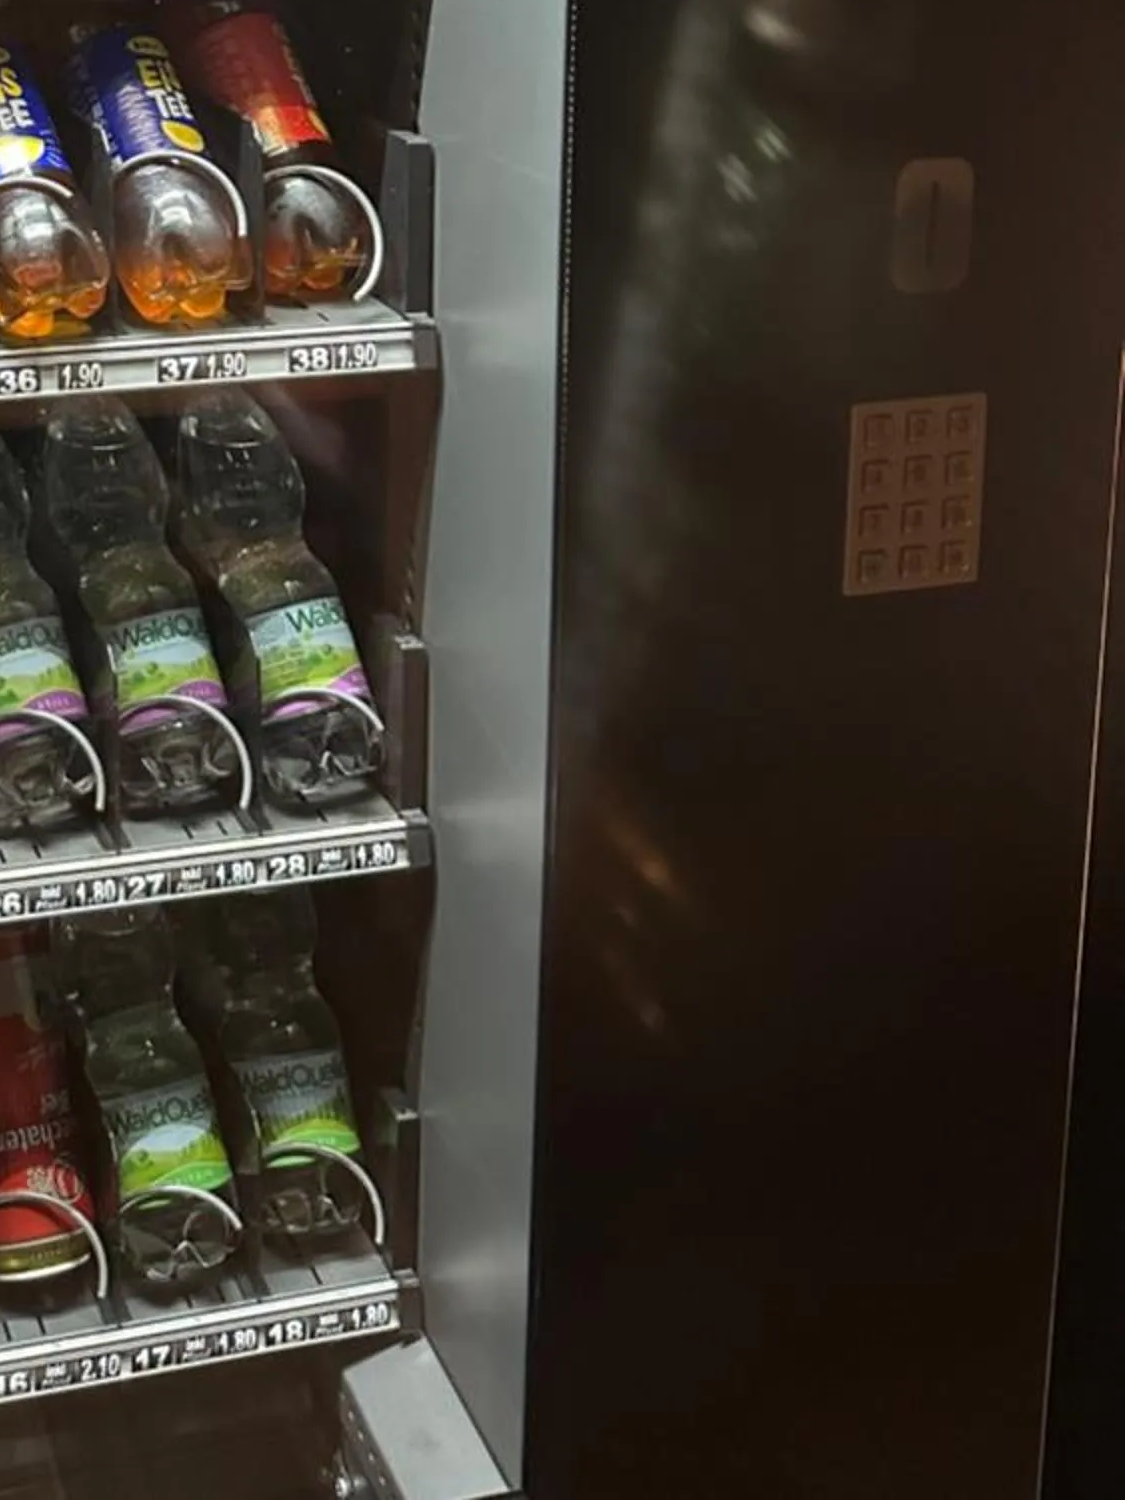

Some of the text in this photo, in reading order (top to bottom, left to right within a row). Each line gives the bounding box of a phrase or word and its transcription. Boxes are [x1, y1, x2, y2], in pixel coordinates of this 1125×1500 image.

[159, 352, 246, 383] 37 1.90
[290, 342, 377, 373] 38 1.90
[60, 363, 103, 388] 1.90
[268, 853, 307, 881] 28
[356, 841, 396, 868] 1.80
[76, 878, 117, 906] 1.80
[126, 872, 166, 900] 27
[215, 860, 256, 887] 1.80
[267, 1319, 306, 1345] 18
[351, 1302, 390, 1330] 1.80
[134, 1344, 172, 1371] 17
[218, 1327, 257, 1353] 1.80
[80, 1353, 121, 1381] 2.10
